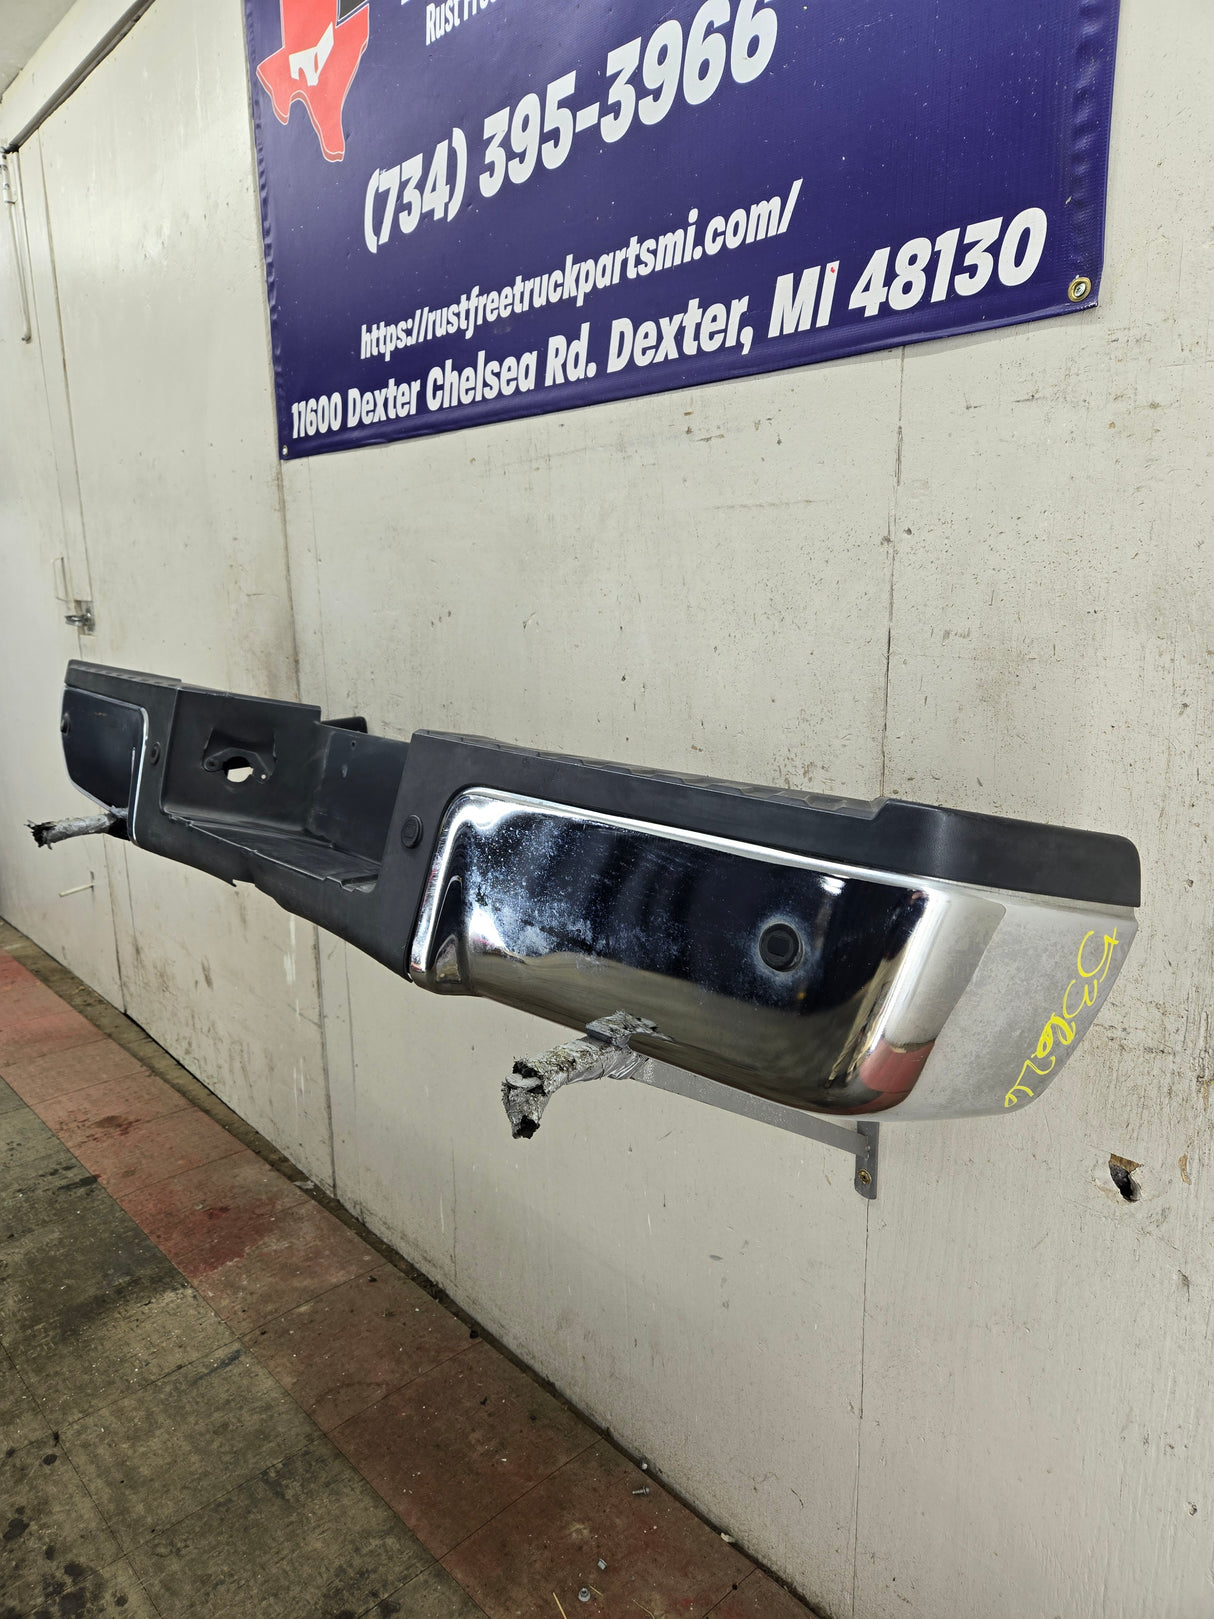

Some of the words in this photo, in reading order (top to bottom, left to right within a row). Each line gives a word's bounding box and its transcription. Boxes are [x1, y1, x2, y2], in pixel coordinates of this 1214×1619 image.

[363, 127, 468, 254] (734)
[478, 0, 778, 198] 395-3966
[425, 0, 461, 46] Rust
[291, 391, 343, 439] 11600
[346, 378, 421, 429] Dexter
[426, 350, 538, 412] Chelsea
[544, 320, 598, 387] Rd.
[606, 295, 754, 374] Dexter,
[767, 260, 840, 339] MI
[848, 206, 1048, 318] 48130
[360, 178, 804, 362] https://rustfreetruckpartsmi.com/
